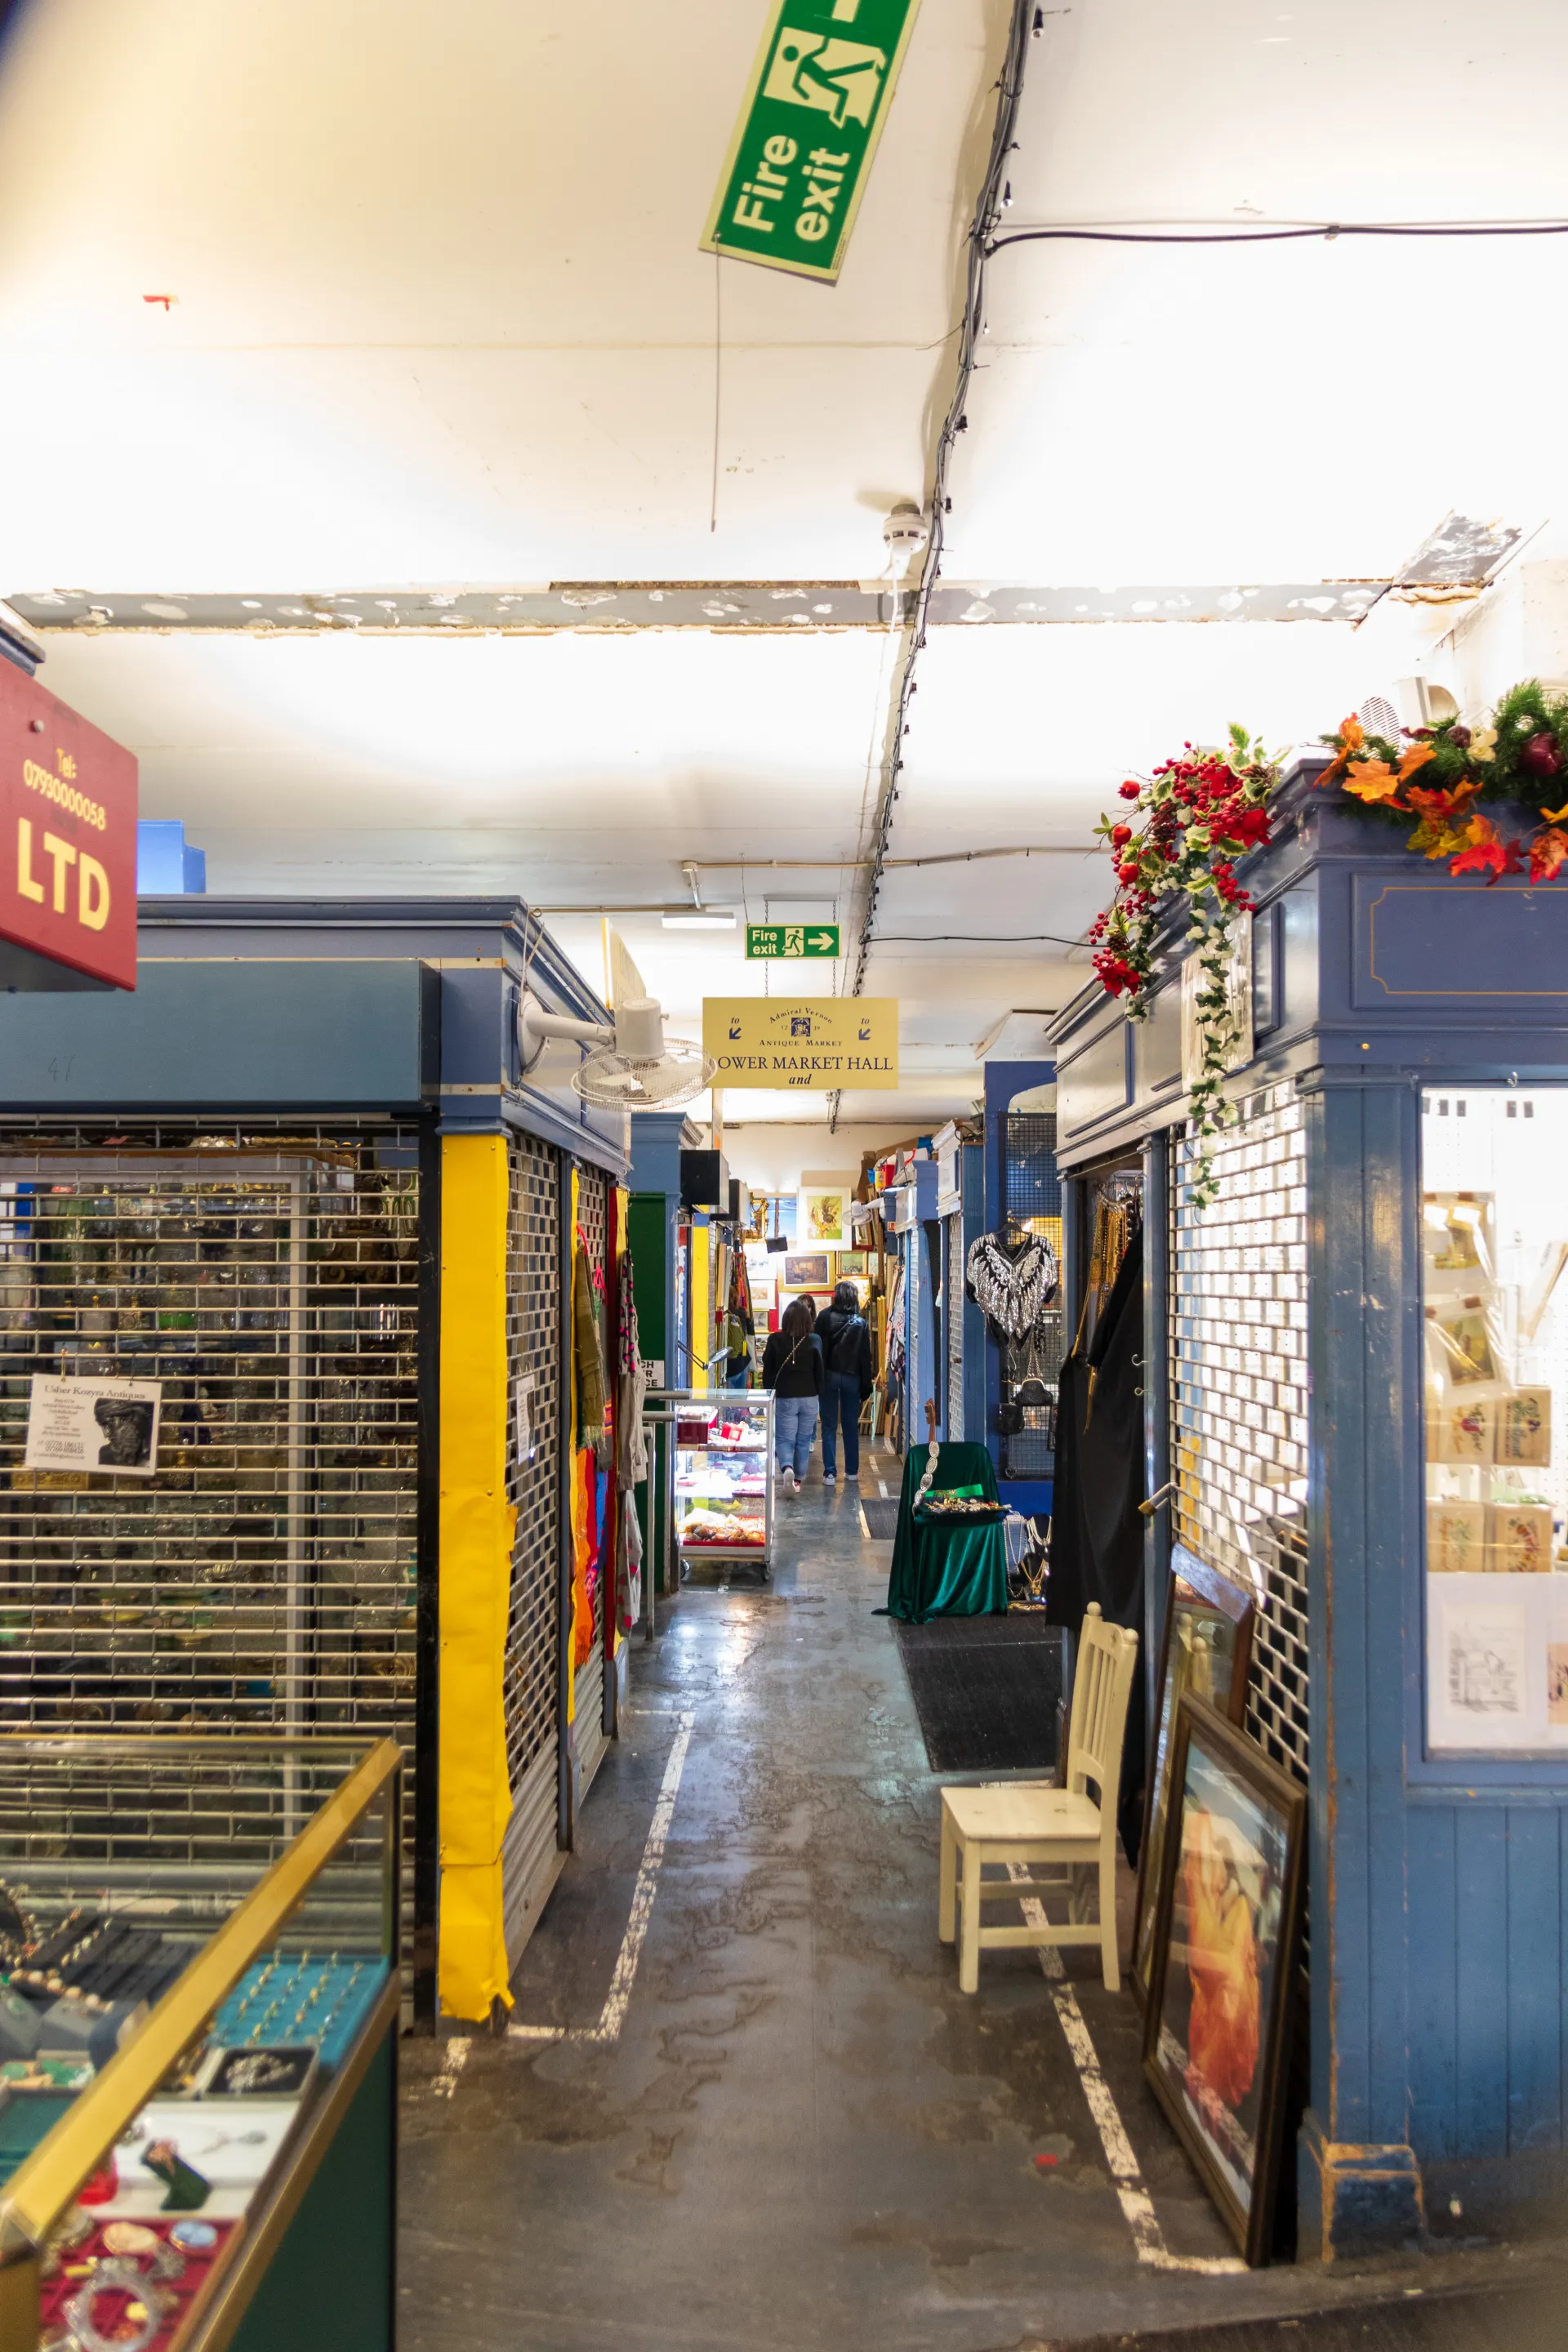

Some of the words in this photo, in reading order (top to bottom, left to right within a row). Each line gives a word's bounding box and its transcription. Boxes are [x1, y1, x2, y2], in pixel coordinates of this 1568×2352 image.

[733, 135, 799, 233] Fire
[795, 148, 851, 242] exit
[56, 748, 77, 779] Tel:
[24, 759, 107, 831] 07930000058
[18, 817, 111, 932] LTD
[752, 929, 777, 942] Fire
[752, 943, 777, 955] exit
[768, 1007, 802, 1024] Admiral
[804, 1007, 833, 1024] Vernon
[718, 1056, 768, 1070] OWER
[772, 1056, 843, 1070] MARKET
[847, 1057, 893, 1071] HALL
[788, 1073, 813, 1085] and
[44, 1384, 71, 1395] Usher
[73, 1387, 105, 1398] Kozyra
[106, 1389, 146, 1401] Antiques
